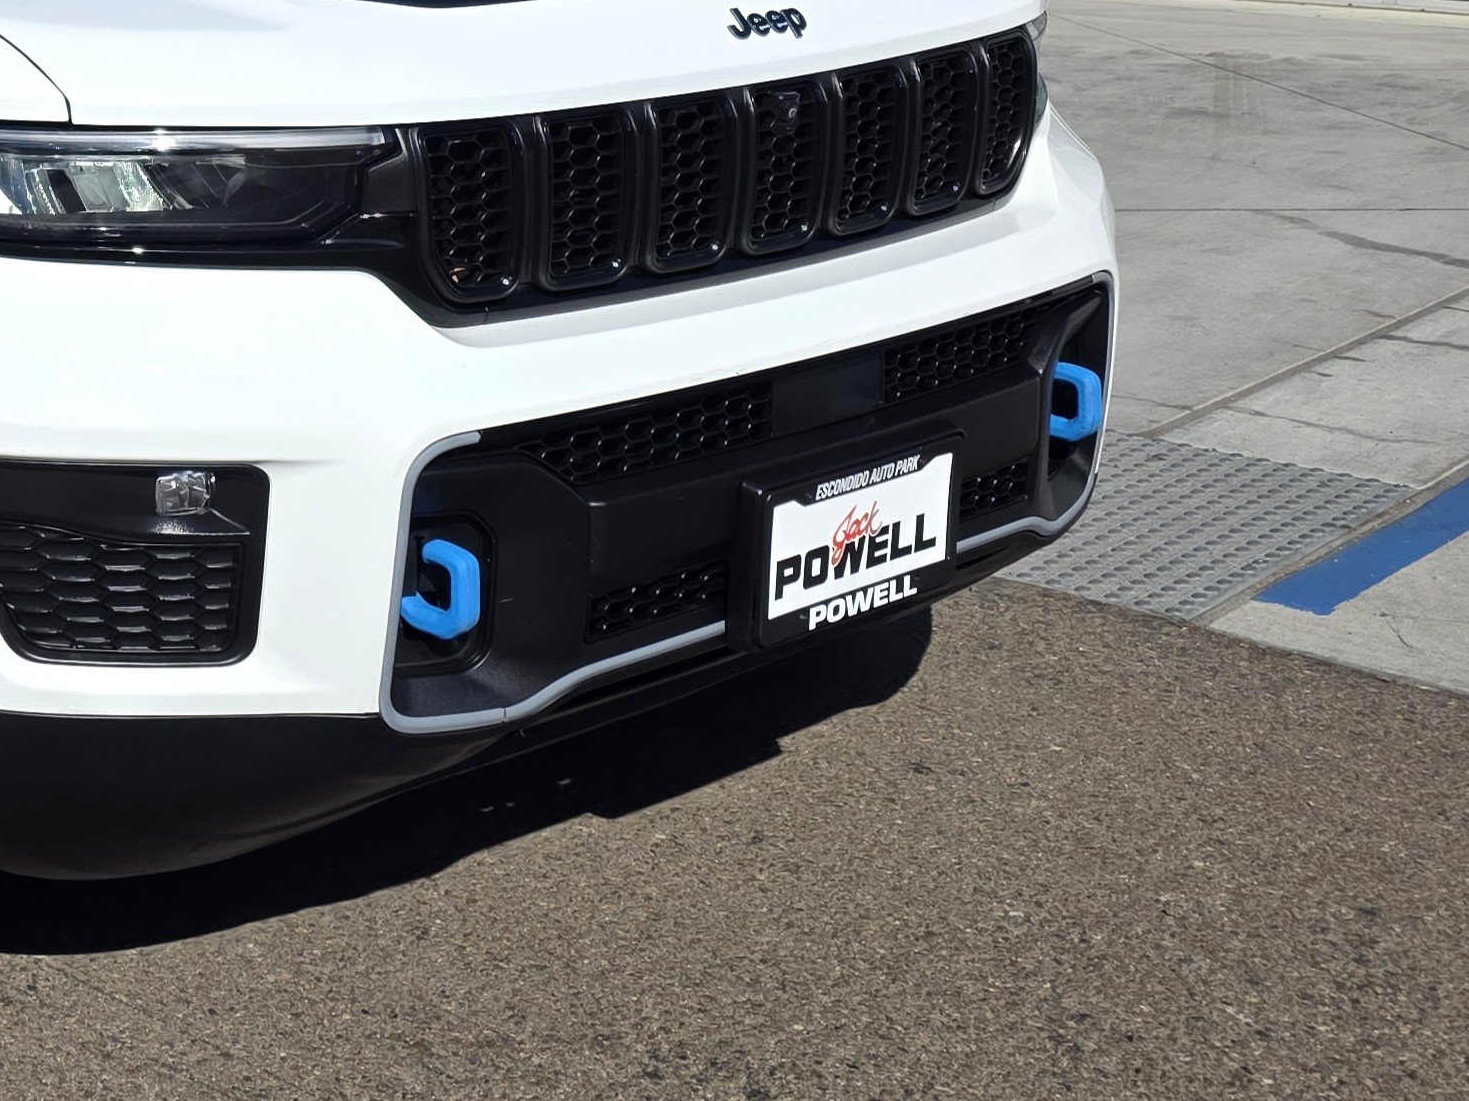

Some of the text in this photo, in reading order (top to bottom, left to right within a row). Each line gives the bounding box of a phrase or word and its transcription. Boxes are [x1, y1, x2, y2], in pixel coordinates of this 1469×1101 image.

[726, 7, 807, 40] Jeep
[815, 454, 921, 501] ESCONDIDO AUTO PARK
[774, 512, 937, 602] POWELL
[831, 500, 883, 567] Jack
[808, 575, 918, 631] POWELL
